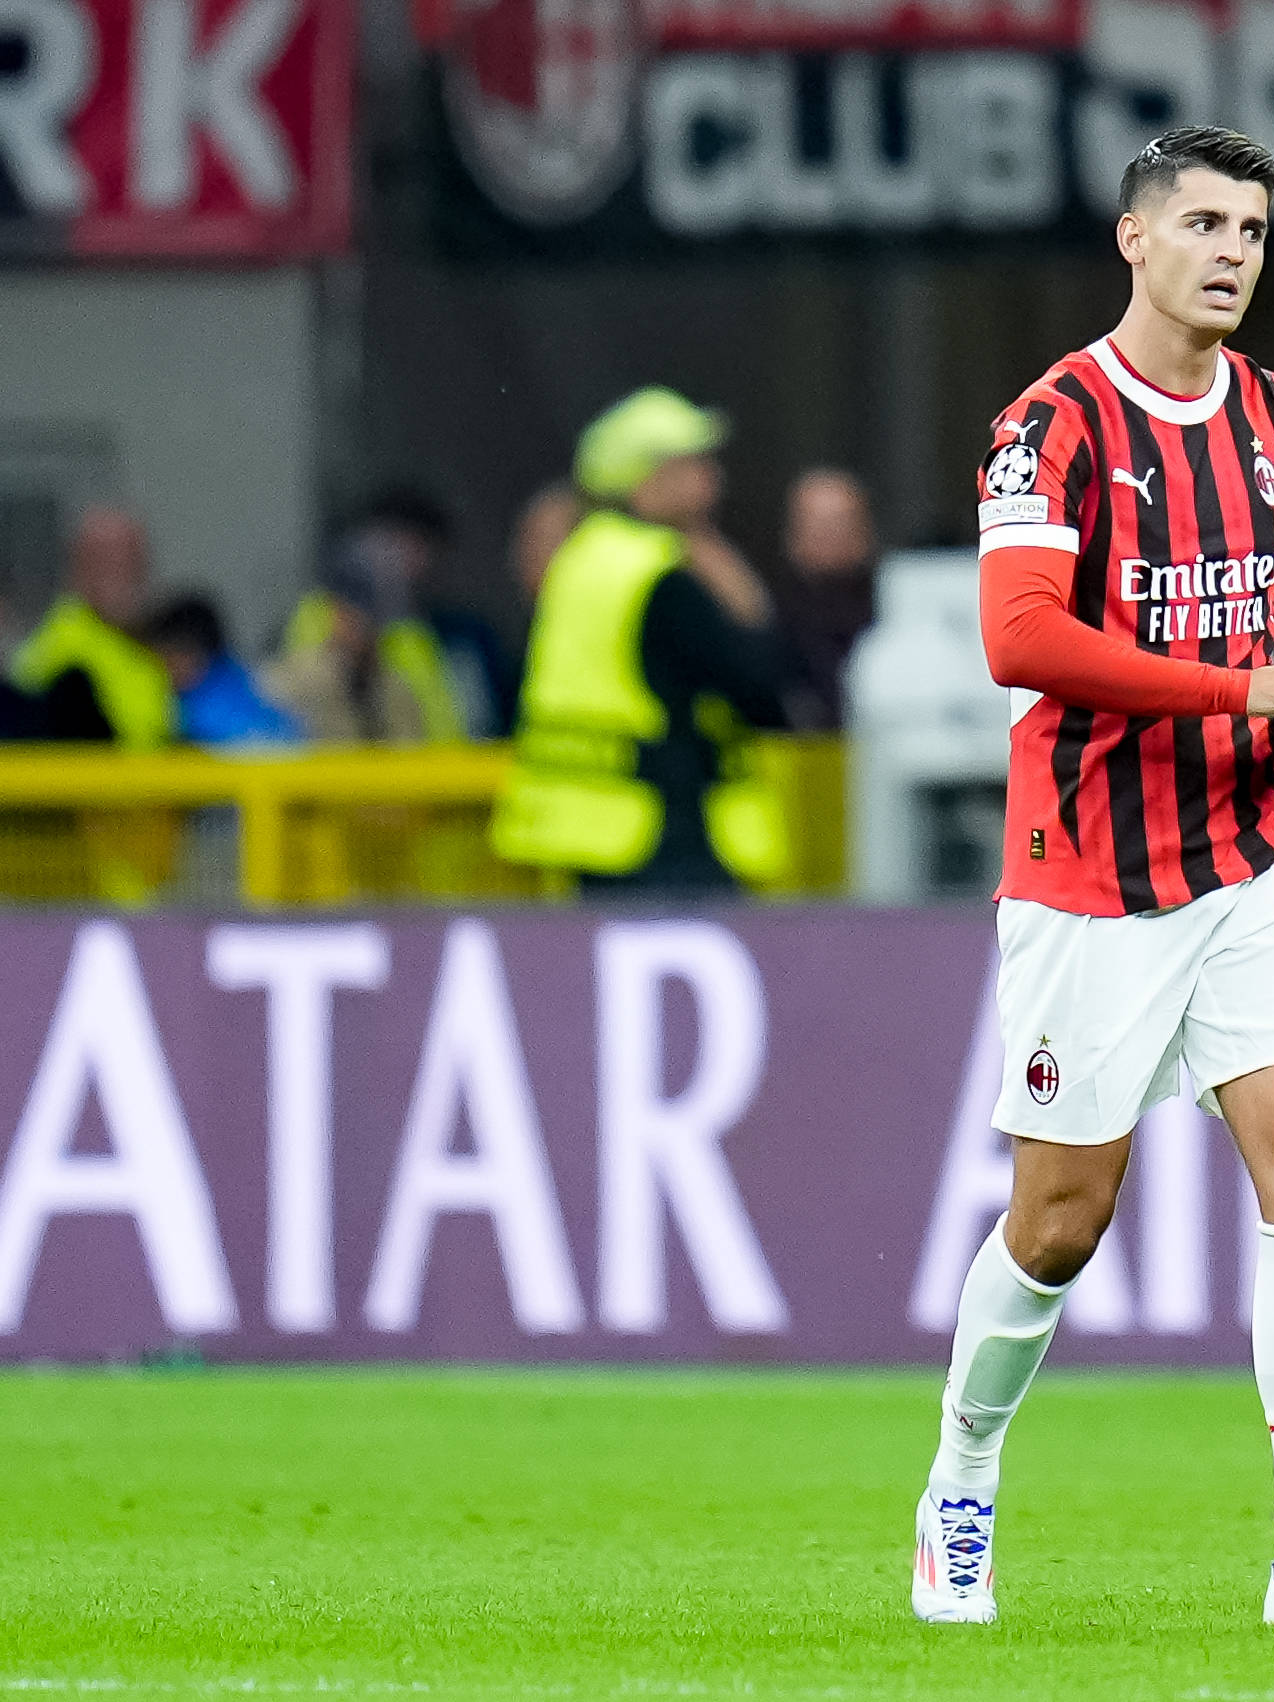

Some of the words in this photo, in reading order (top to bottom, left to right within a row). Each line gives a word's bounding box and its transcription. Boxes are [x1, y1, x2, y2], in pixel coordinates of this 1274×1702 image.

[642, 50, 1060, 232] CLUB
[1148, 604, 1190, 643] FLY
[1197, 596, 1266, 640] BETTER
